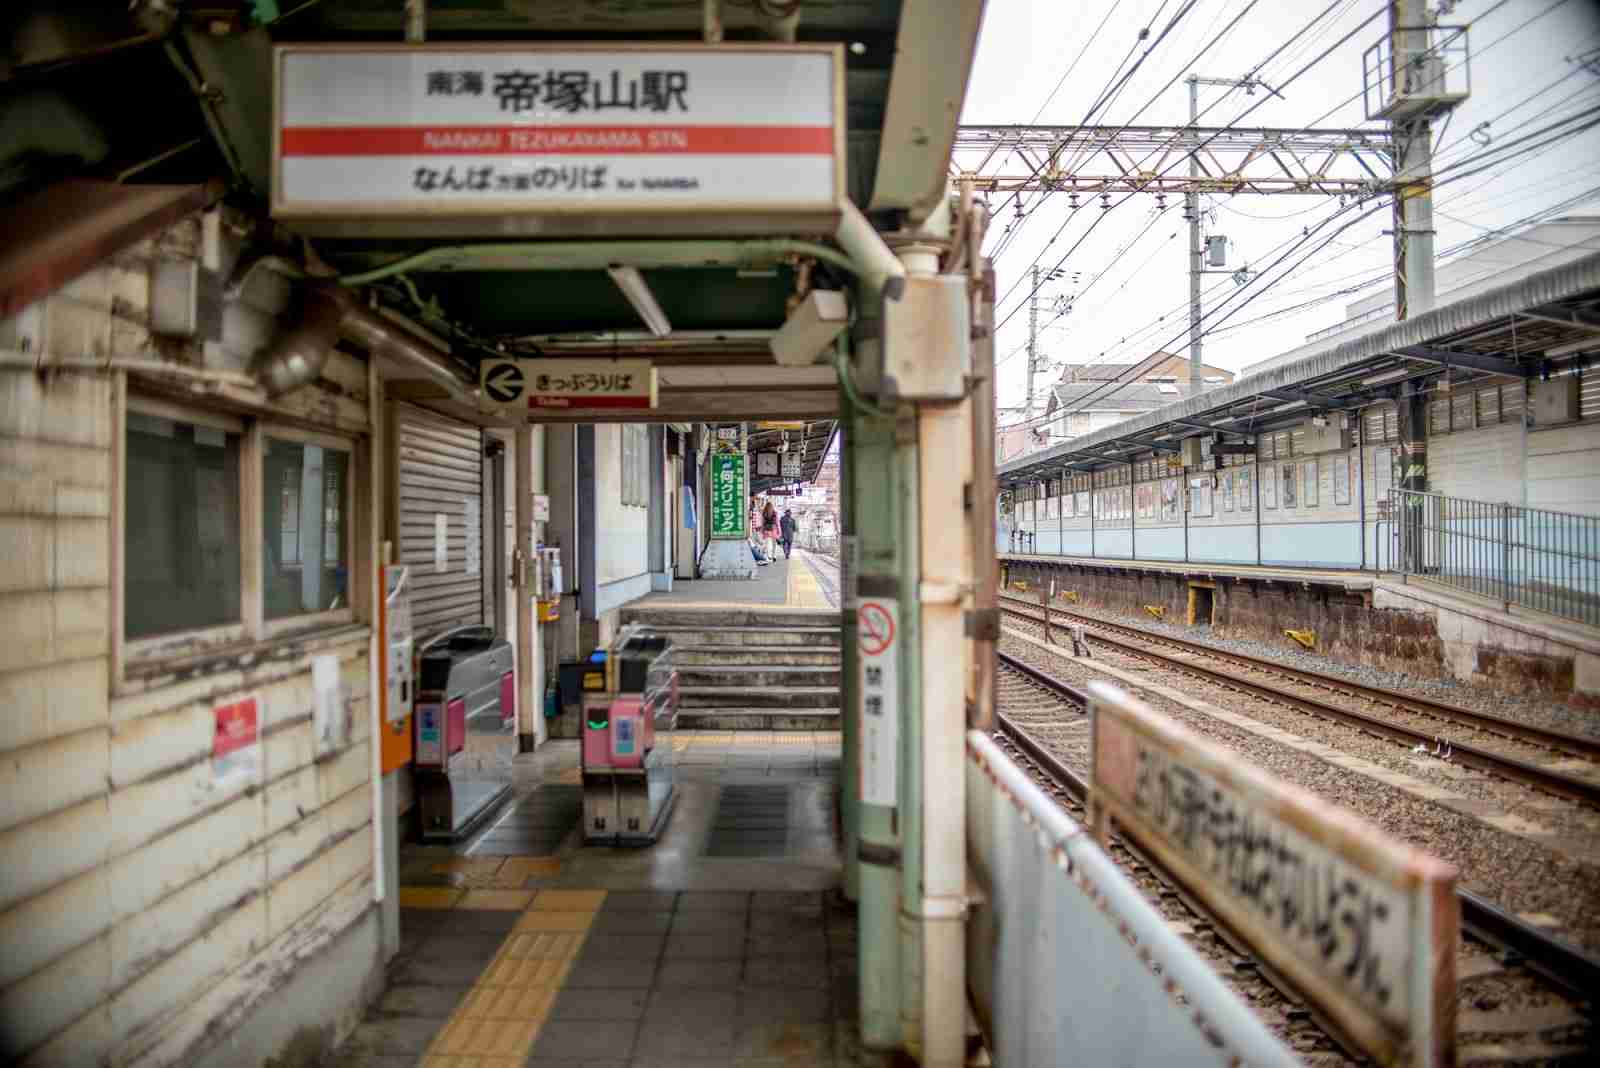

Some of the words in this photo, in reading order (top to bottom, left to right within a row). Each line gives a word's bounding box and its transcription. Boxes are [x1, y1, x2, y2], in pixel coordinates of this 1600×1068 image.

[426, 71, 484, 96] 南海
[493, 69, 689, 112] 帝塚山駅
[424, 132, 499, 149] NANKAI
[509, 132, 641, 149] TEZUKAYAMA
[536, 374, 633, 391] きっぷうりば
